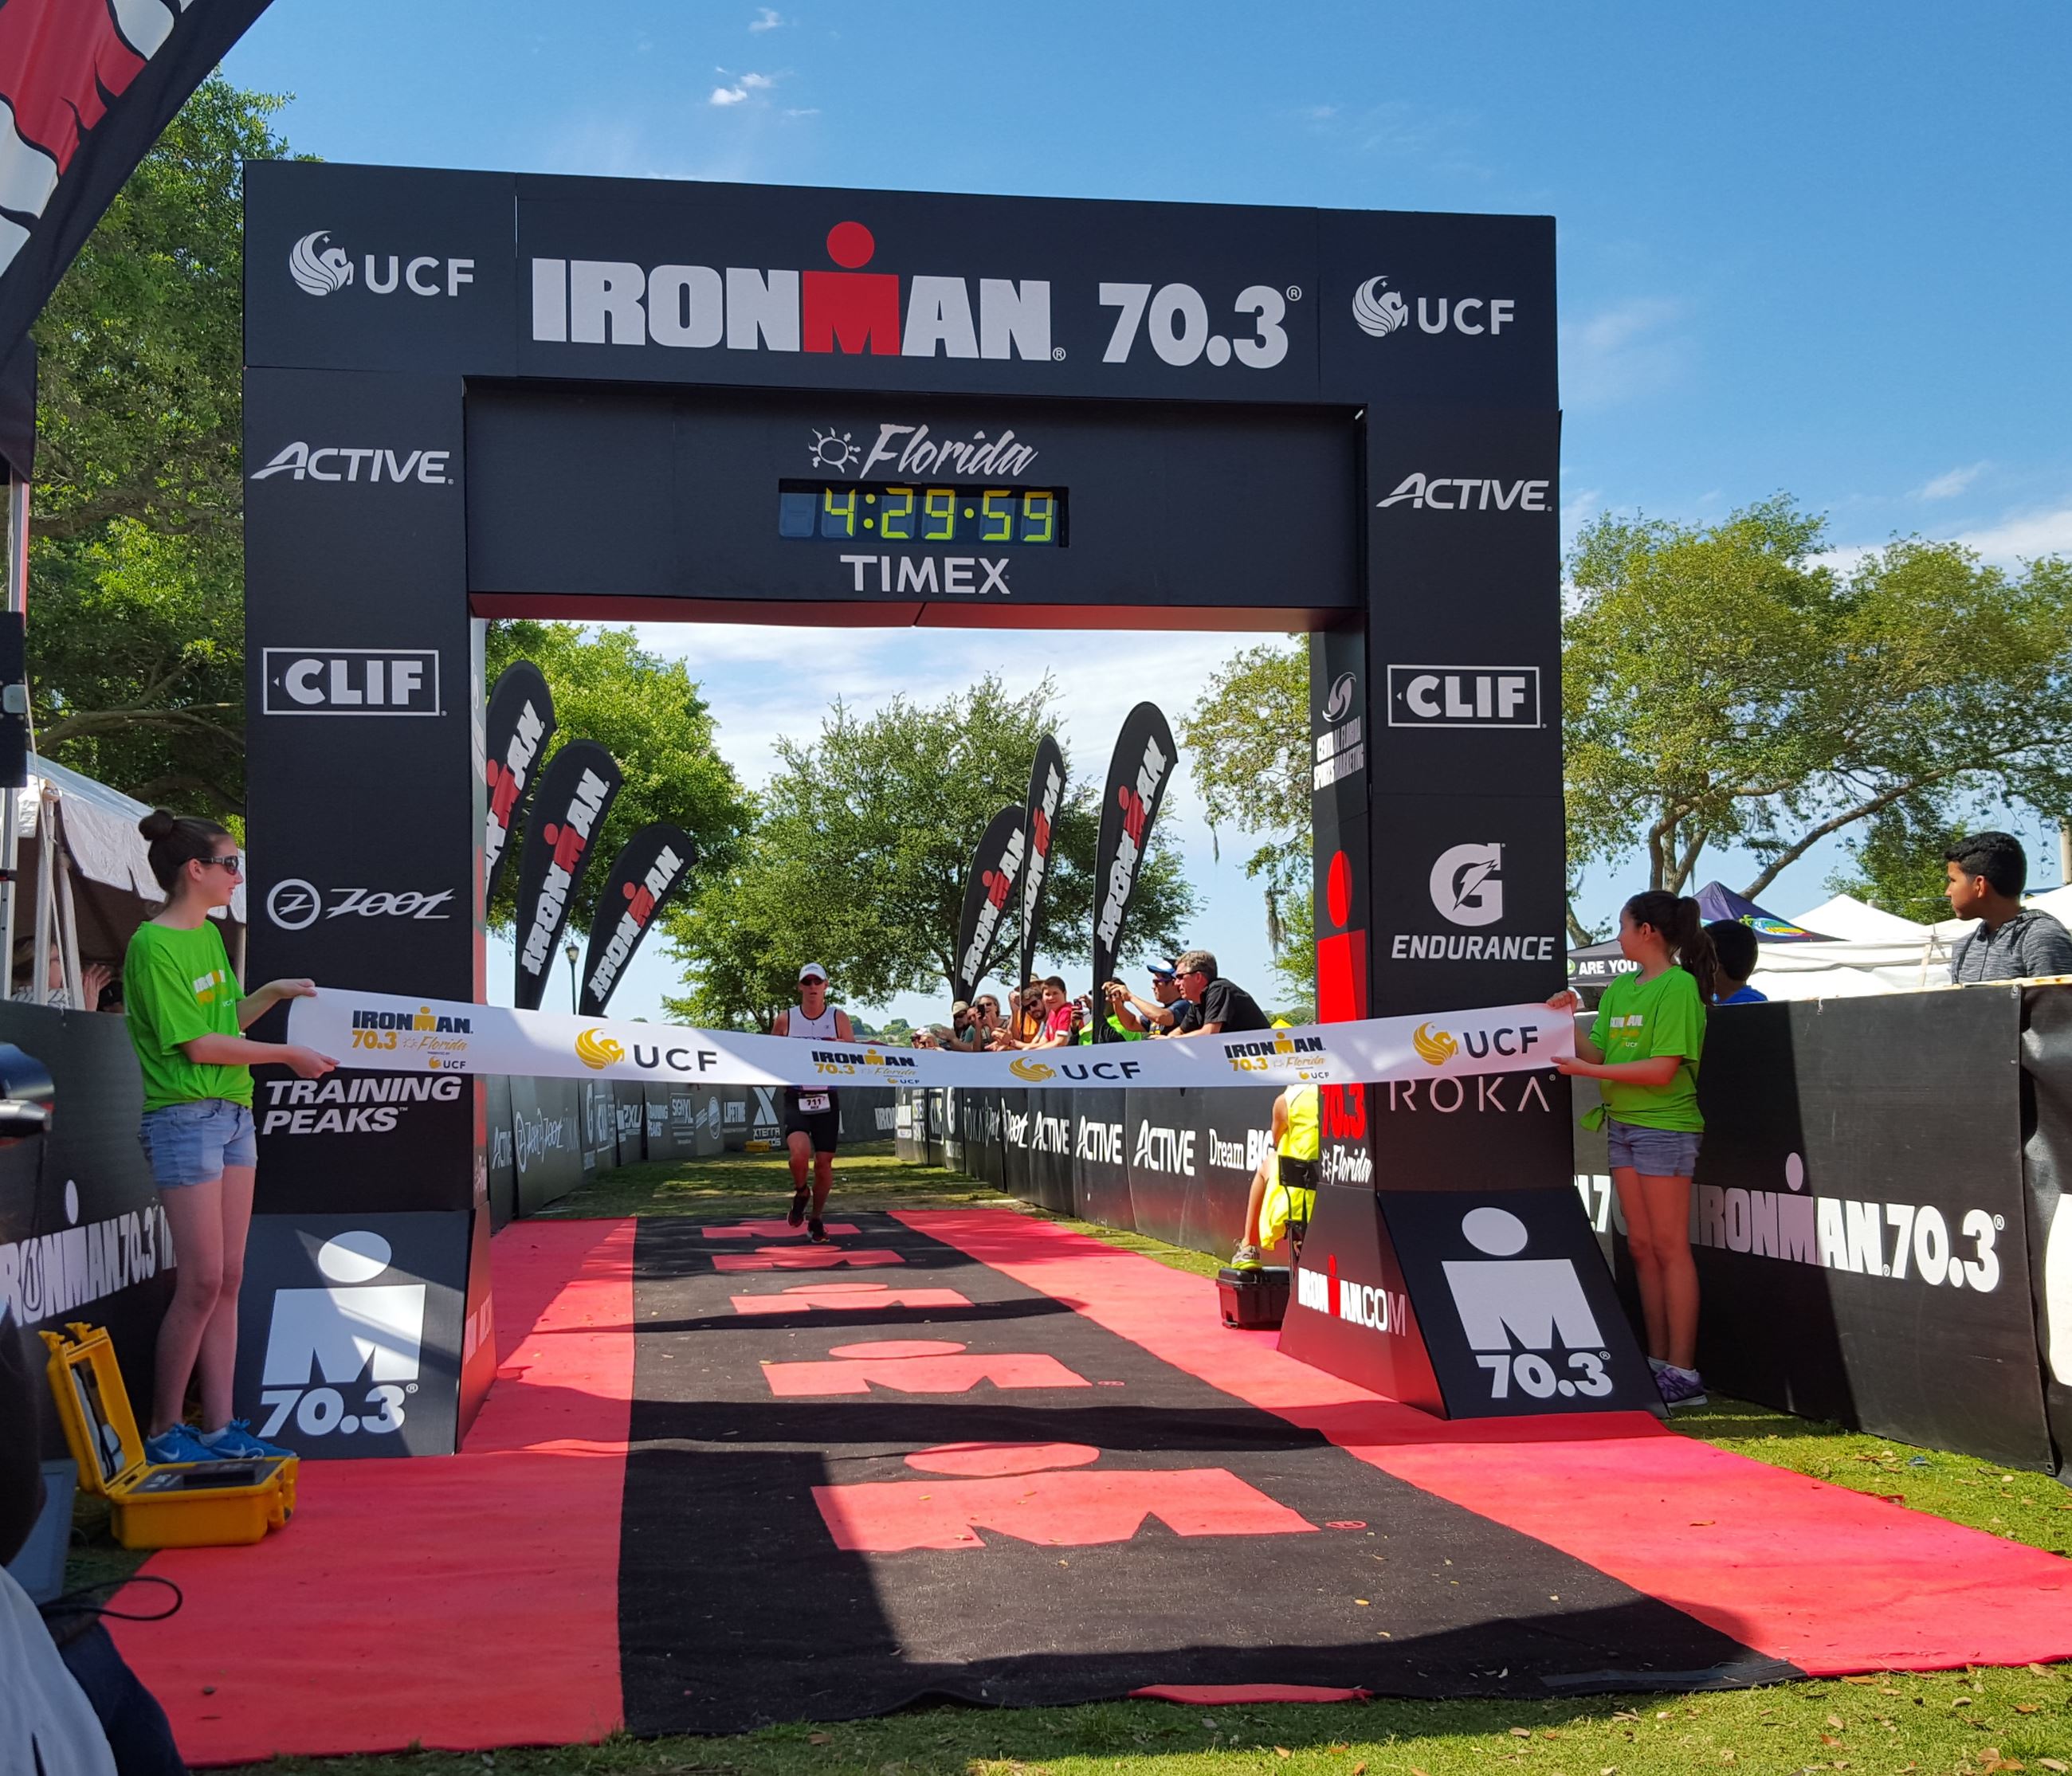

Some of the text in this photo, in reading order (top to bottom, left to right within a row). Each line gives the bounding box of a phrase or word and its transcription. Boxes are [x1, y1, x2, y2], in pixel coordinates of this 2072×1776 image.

[365, 254, 474, 296] UCF
[532, 222, 1289, 369] IRONMAN 70.3
[1418, 296, 1514, 335] UCF
[250, 441, 449, 485] ACTIVE
[861, 423, 1038, 479] Florida
[1376, 472, 1549, 512] ACTIVE
[839, 555, 1011, 594] TIMEX
[285, 659, 423, 705] CLIF
[1405, 674, 1528, 723] CLIF
[1097, 735, 1166, 953] IRONMAN
[522, 766, 609, 976] IRONMAN
[587, 845, 684, 1002] IRONMAN
[961, 827, 1025, 987] IRONMAN
[1391, 935, 1555, 961] ENDURANCE
[1579, 959, 1637, 974] ARE YOU
[352, 1006, 470, 1033] IRONMAN
[352, 1030, 468, 1052] 70.3 Florida
[634, 1044, 716, 1072] UCF
[811, 1049, 915, 1067] IRONMAN
[1224, 1032, 1323, 1058] IRONMAN
[1463, 1025, 1538, 1058] UCF
[443, 1061, 466, 1069] UCF
[814, 1064, 855, 1075] 70.3
[1062, 1061, 1140, 1084] UCF
[1228, 1057, 1268, 1071] 70.3
[265, 1076, 462, 1104] TRAINING
[1321, 1082, 1366, 1139] 70.3
[1390, 1076, 1550, 1112] ROKA
[262, 1106, 398, 1135] PEAKS
[1032, 1111, 1070, 1155] ACTIVE
[1076, 1115, 1123, 1164] ACTIVE
[1133, 1119, 1195, 1176] ACTIVE
[1209, 1128, 1275, 1171] Dream BIG
[1330, 1143, 1372, 1186] Florida
[120, 1206, 157, 1288] 70.3
[1886, 1203, 2000, 1292] 70.3
[1475, 1352, 1613, 1398] 70.3
[257, 1385, 405, 1437] 70.3
